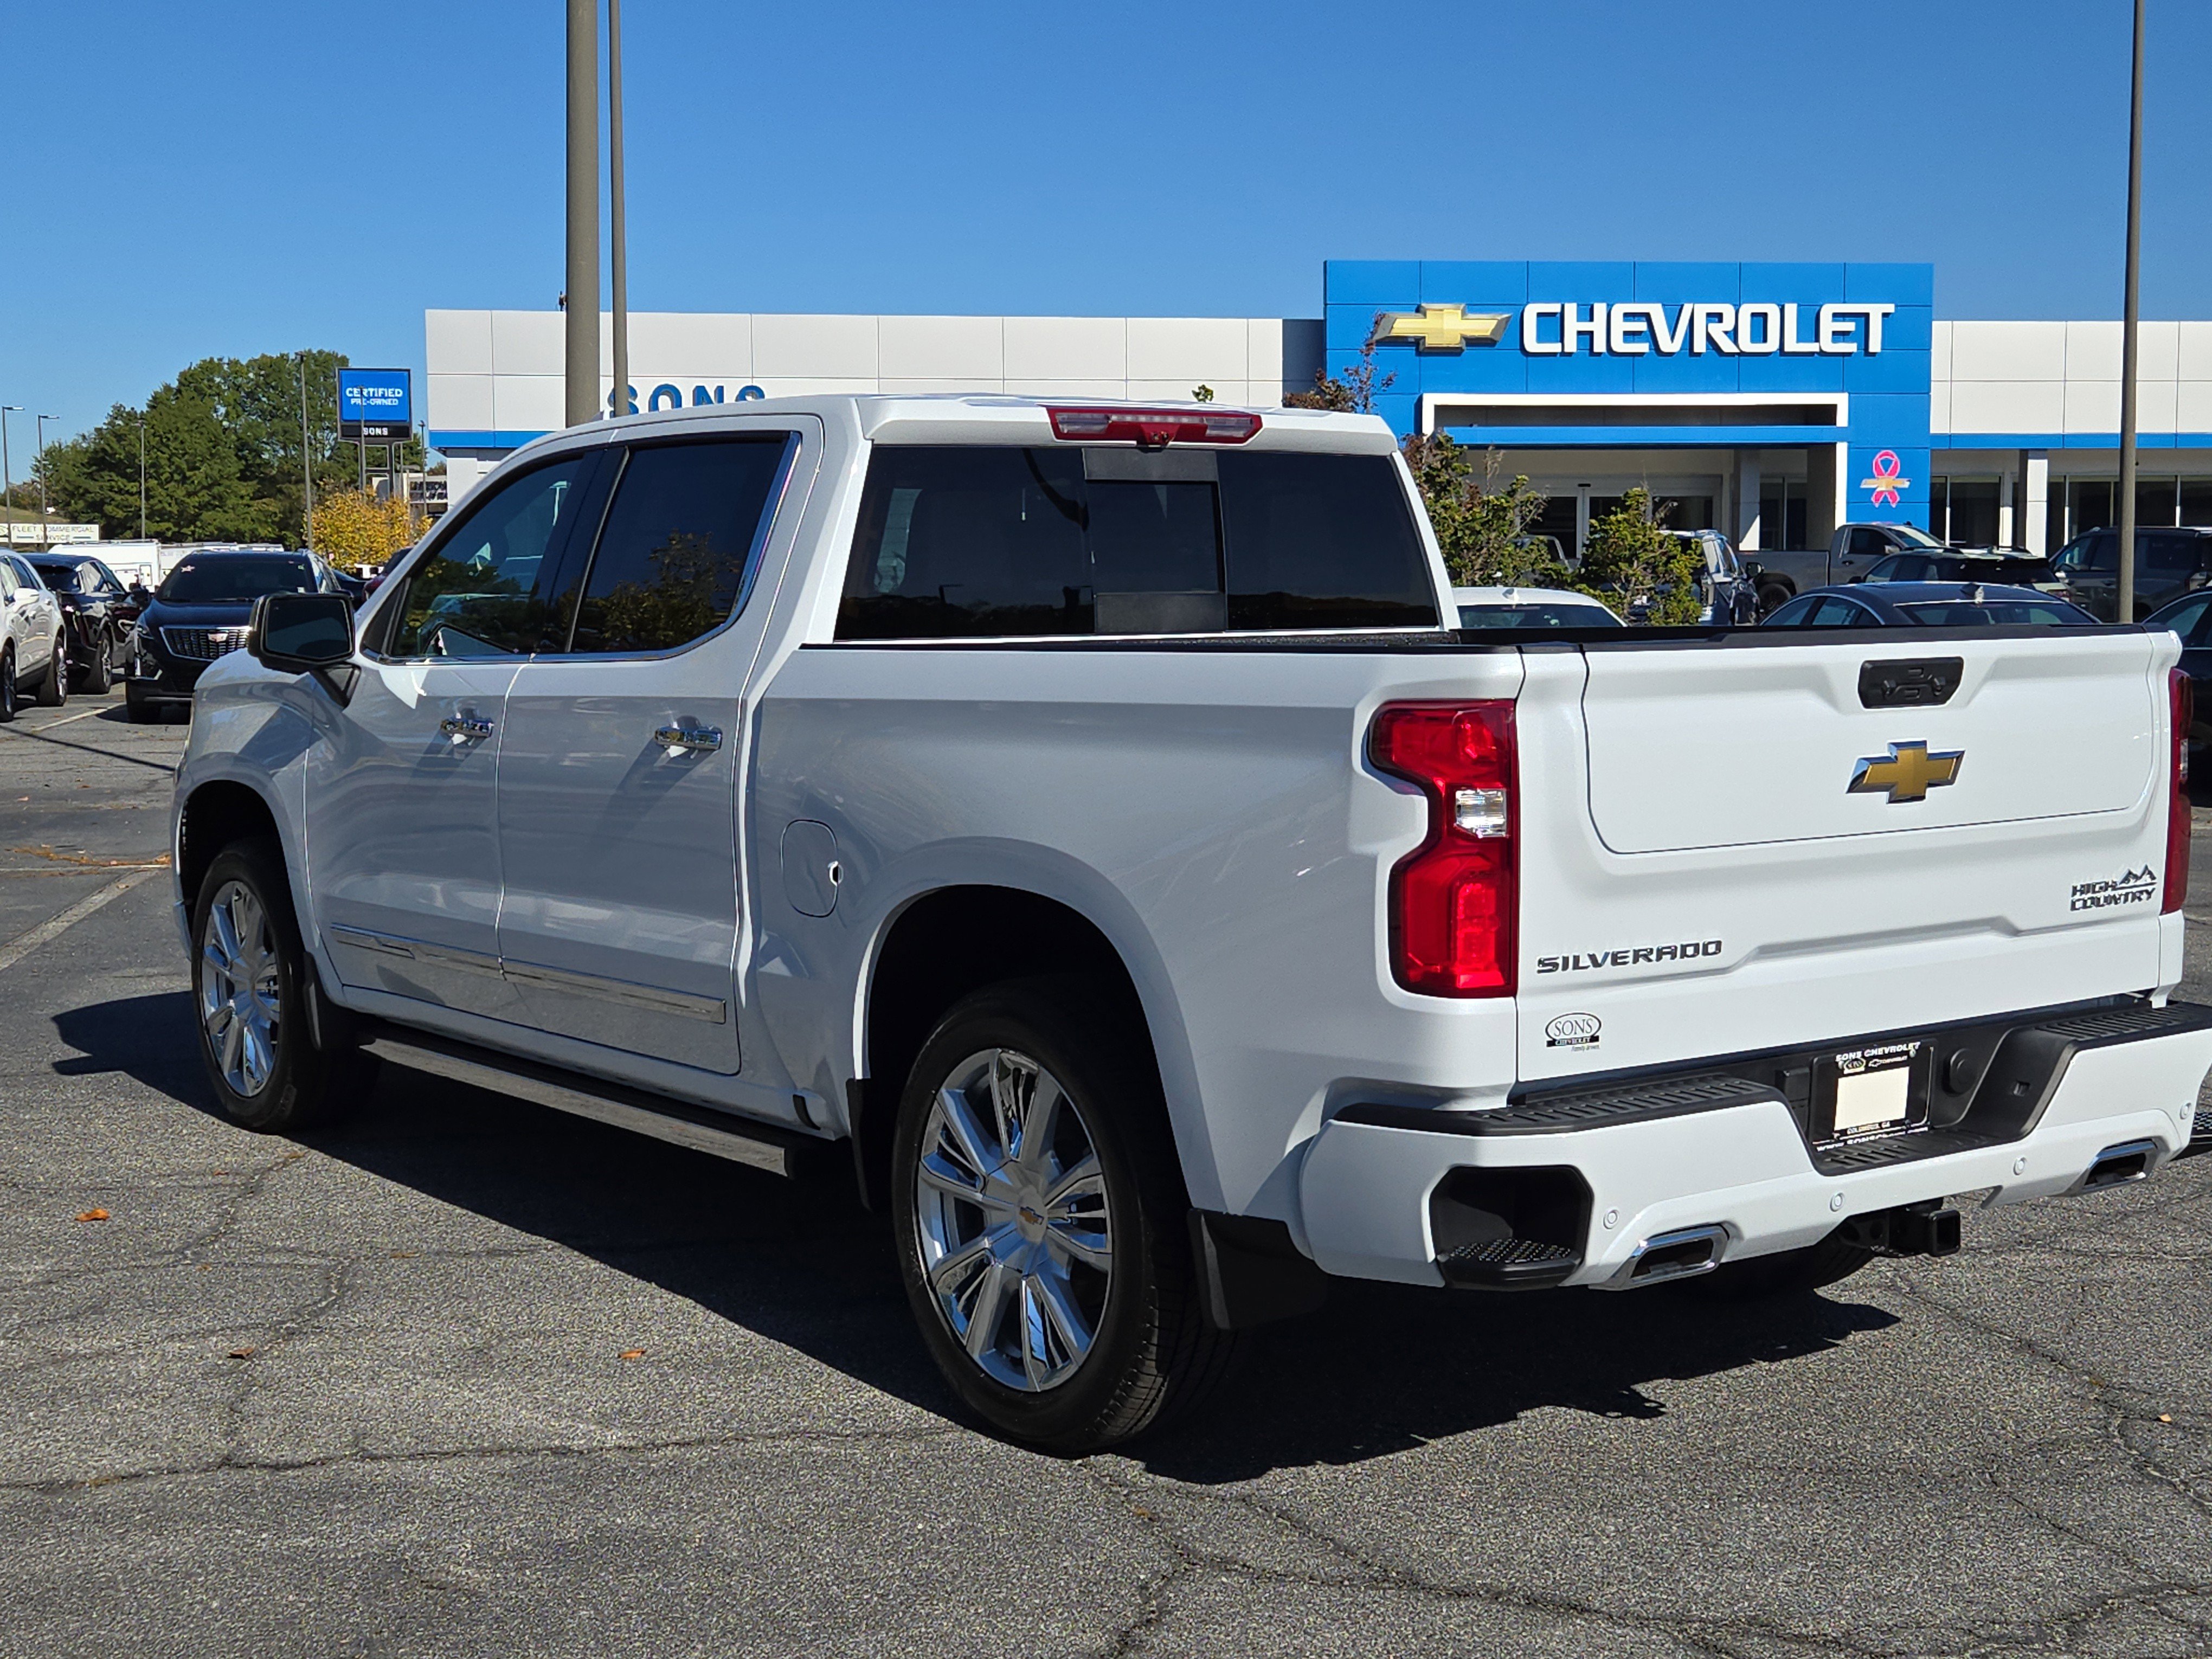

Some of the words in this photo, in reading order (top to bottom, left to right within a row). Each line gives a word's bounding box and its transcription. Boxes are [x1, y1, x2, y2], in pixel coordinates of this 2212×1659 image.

[1523, 303, 1895, 353] CHEVROLET
[345, 388, 403, 397] CERTIFIED
[2071, 880, 2118, 897] HIGH
[2070, 888, 2156, 911] COUNTRY
[1536, 940, 1722, 974] SILVERADO
[1553, 1018, 1593, 1037] SONS
[1863, 1041, 1921, 1057] CHEVROLET
